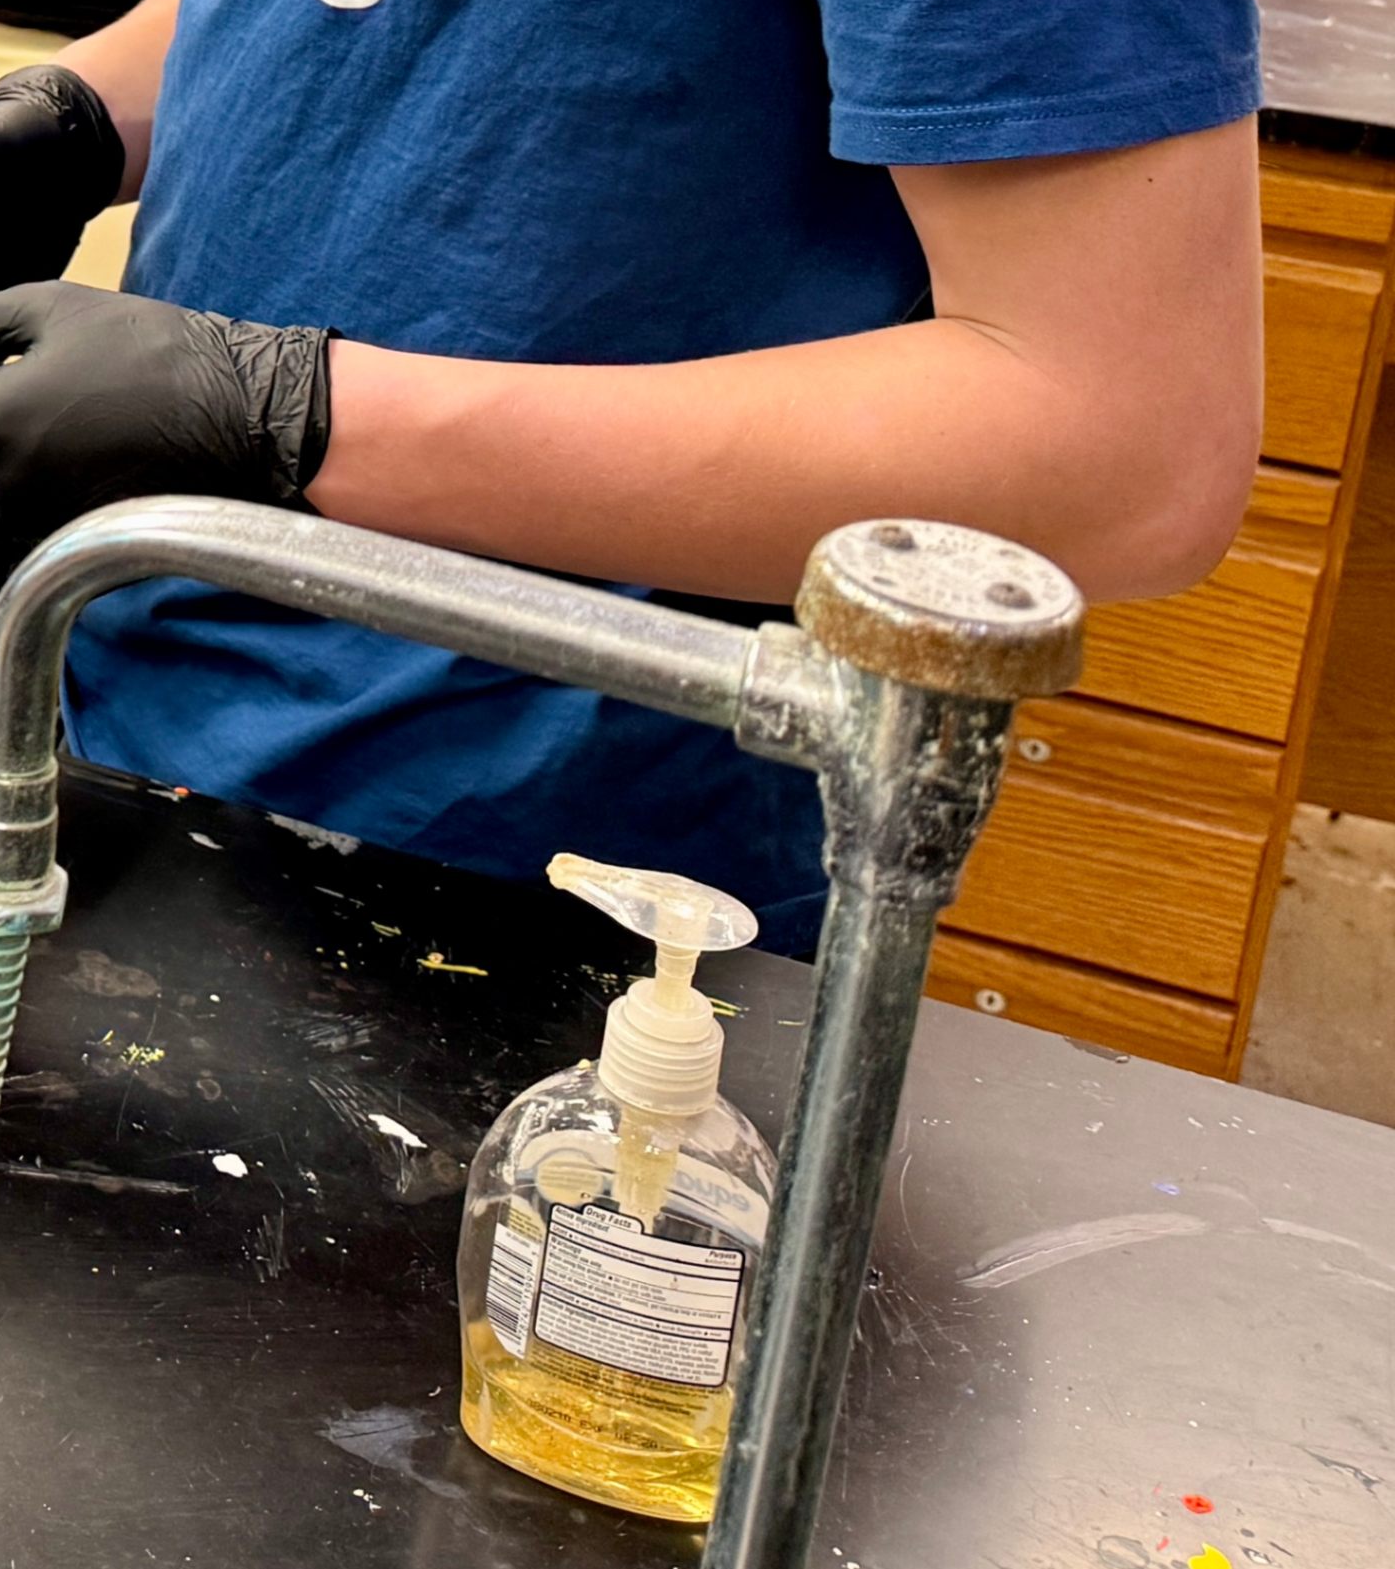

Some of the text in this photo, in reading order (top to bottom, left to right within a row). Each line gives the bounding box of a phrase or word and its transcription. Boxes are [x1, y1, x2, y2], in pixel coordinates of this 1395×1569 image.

[555, 1207, 575, 1220] Active
[575, 1216, 609, 1232] ingredient
[586, 1207, 607, 1222] Drug
[609, 1214, 632, 1229] Facts
[709, 1251, 737, 1260] Purpose
